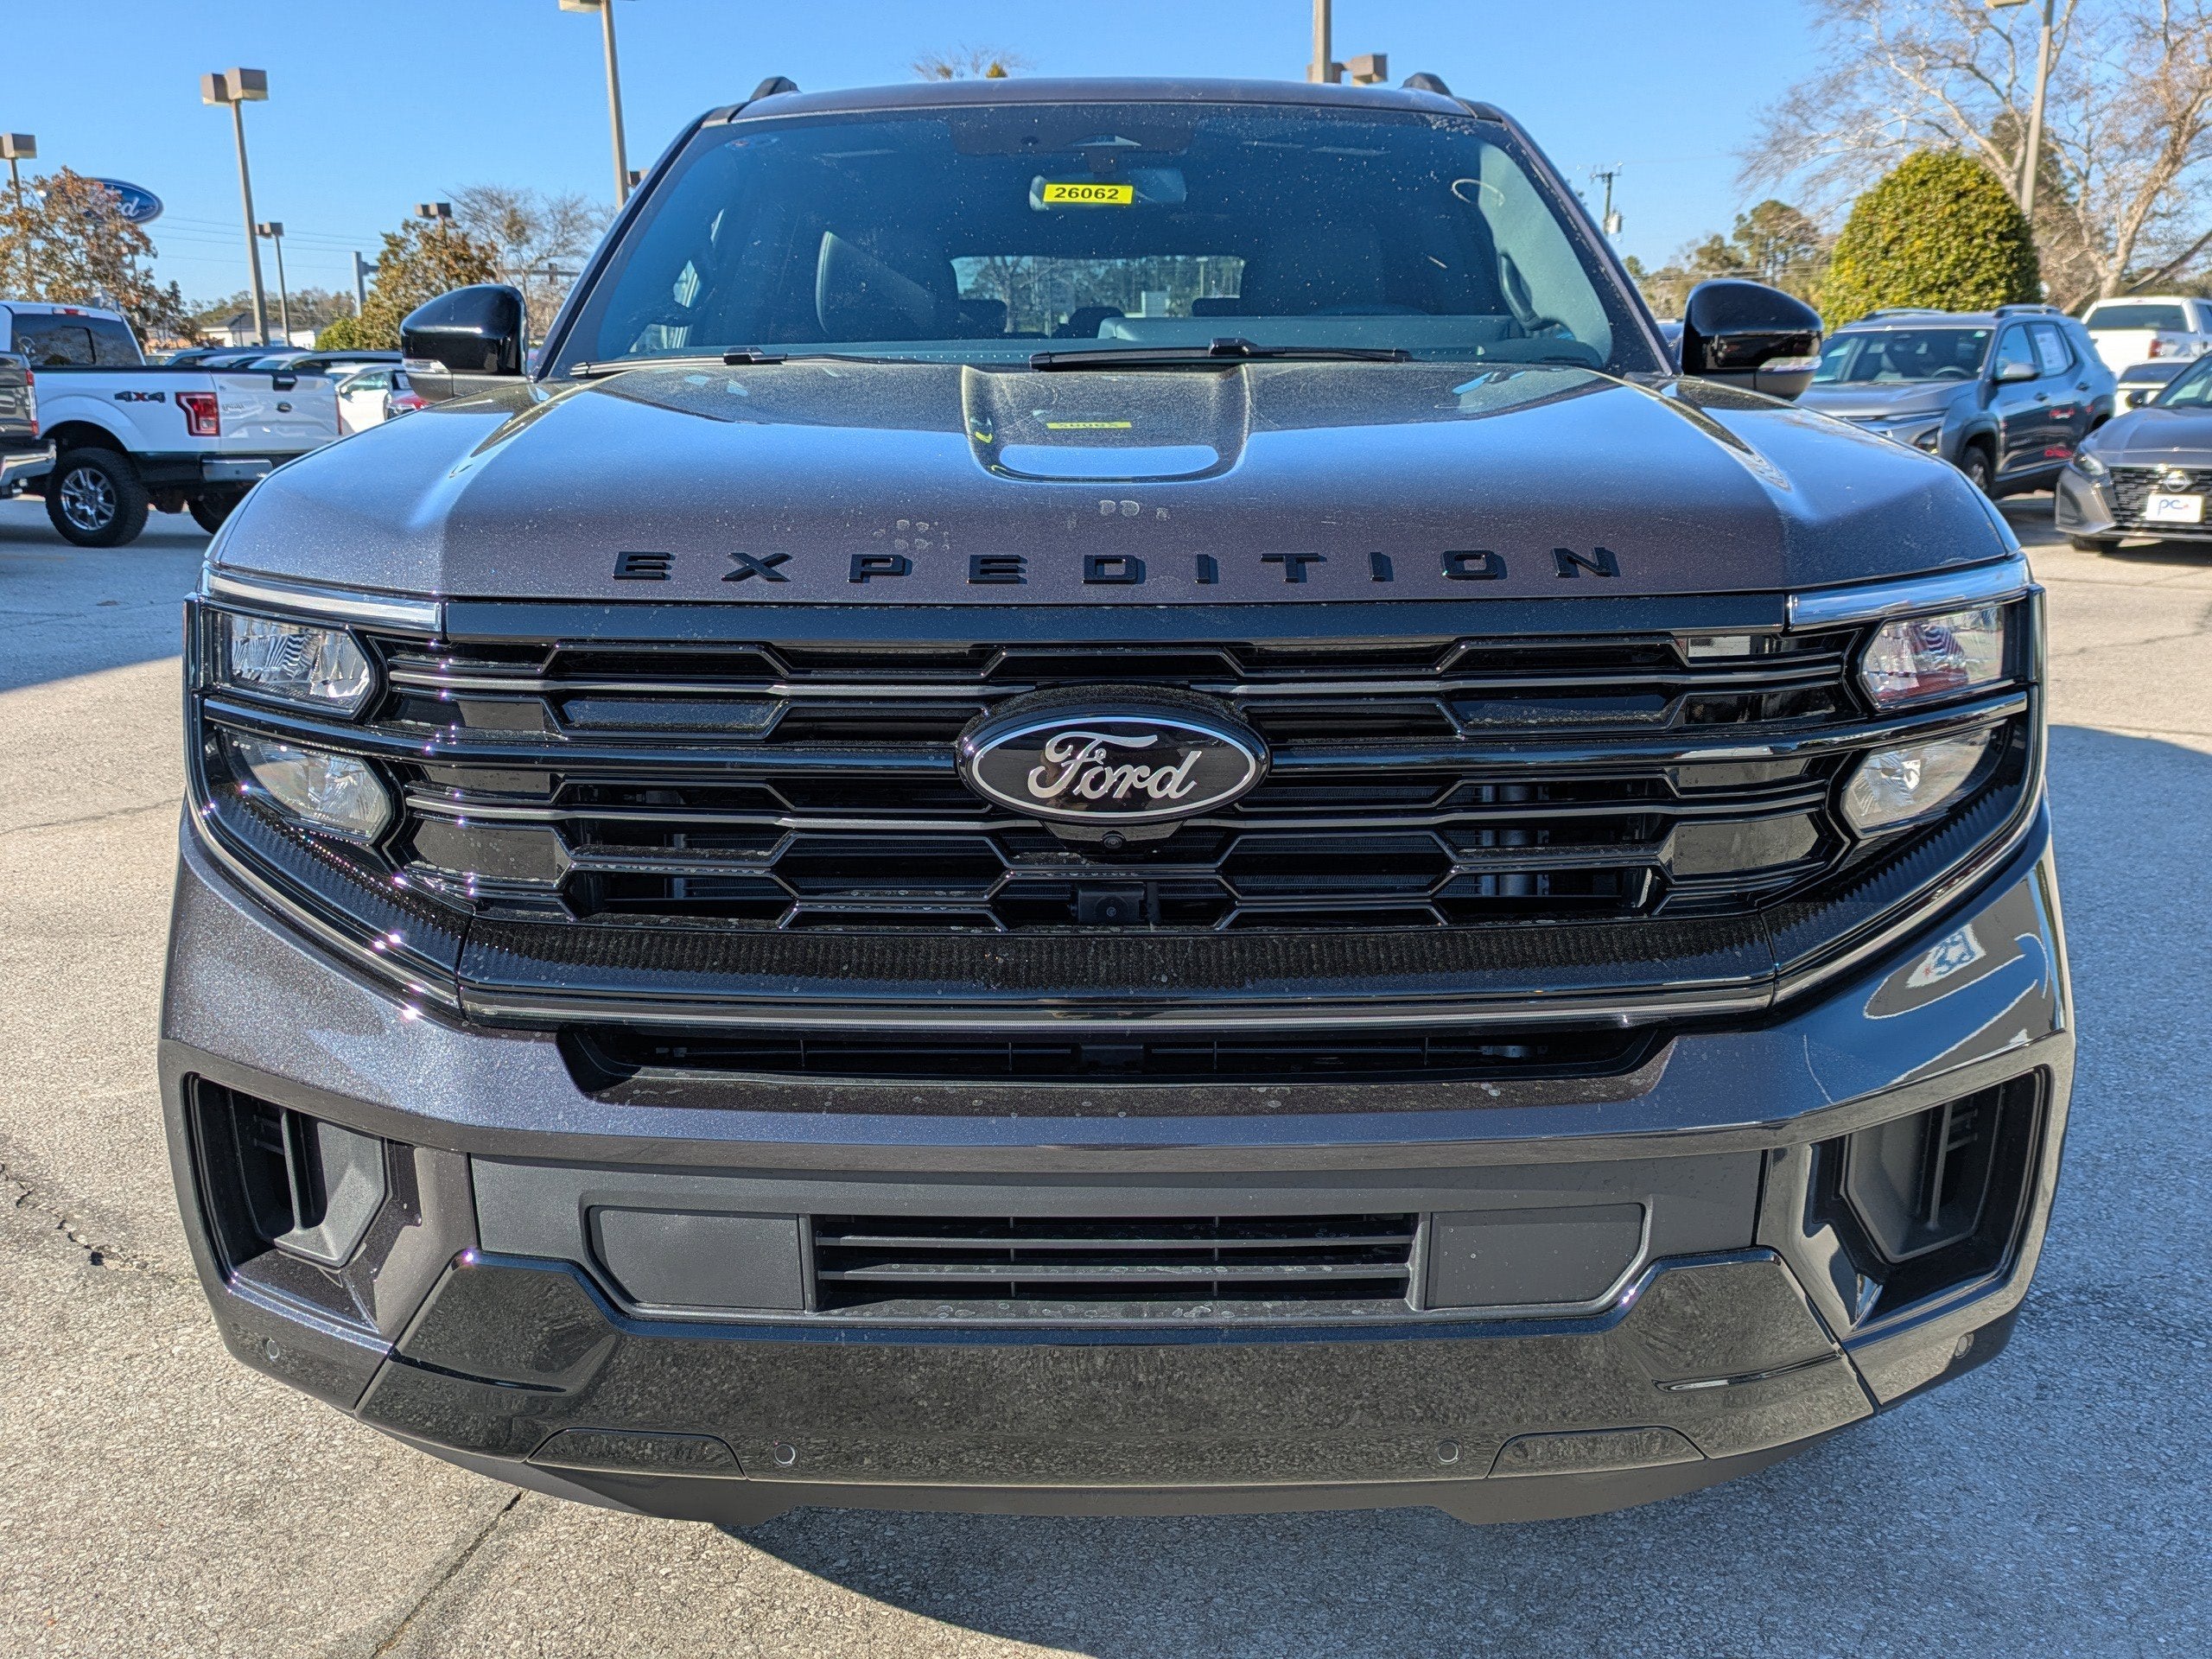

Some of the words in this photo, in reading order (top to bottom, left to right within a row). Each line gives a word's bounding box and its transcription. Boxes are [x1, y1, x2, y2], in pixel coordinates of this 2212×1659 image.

[1054, 187, 1119, 200] 26062
[612, 547, 1618, 585] EXPEDITION
[1027, 731, 1202, 798] Ford
